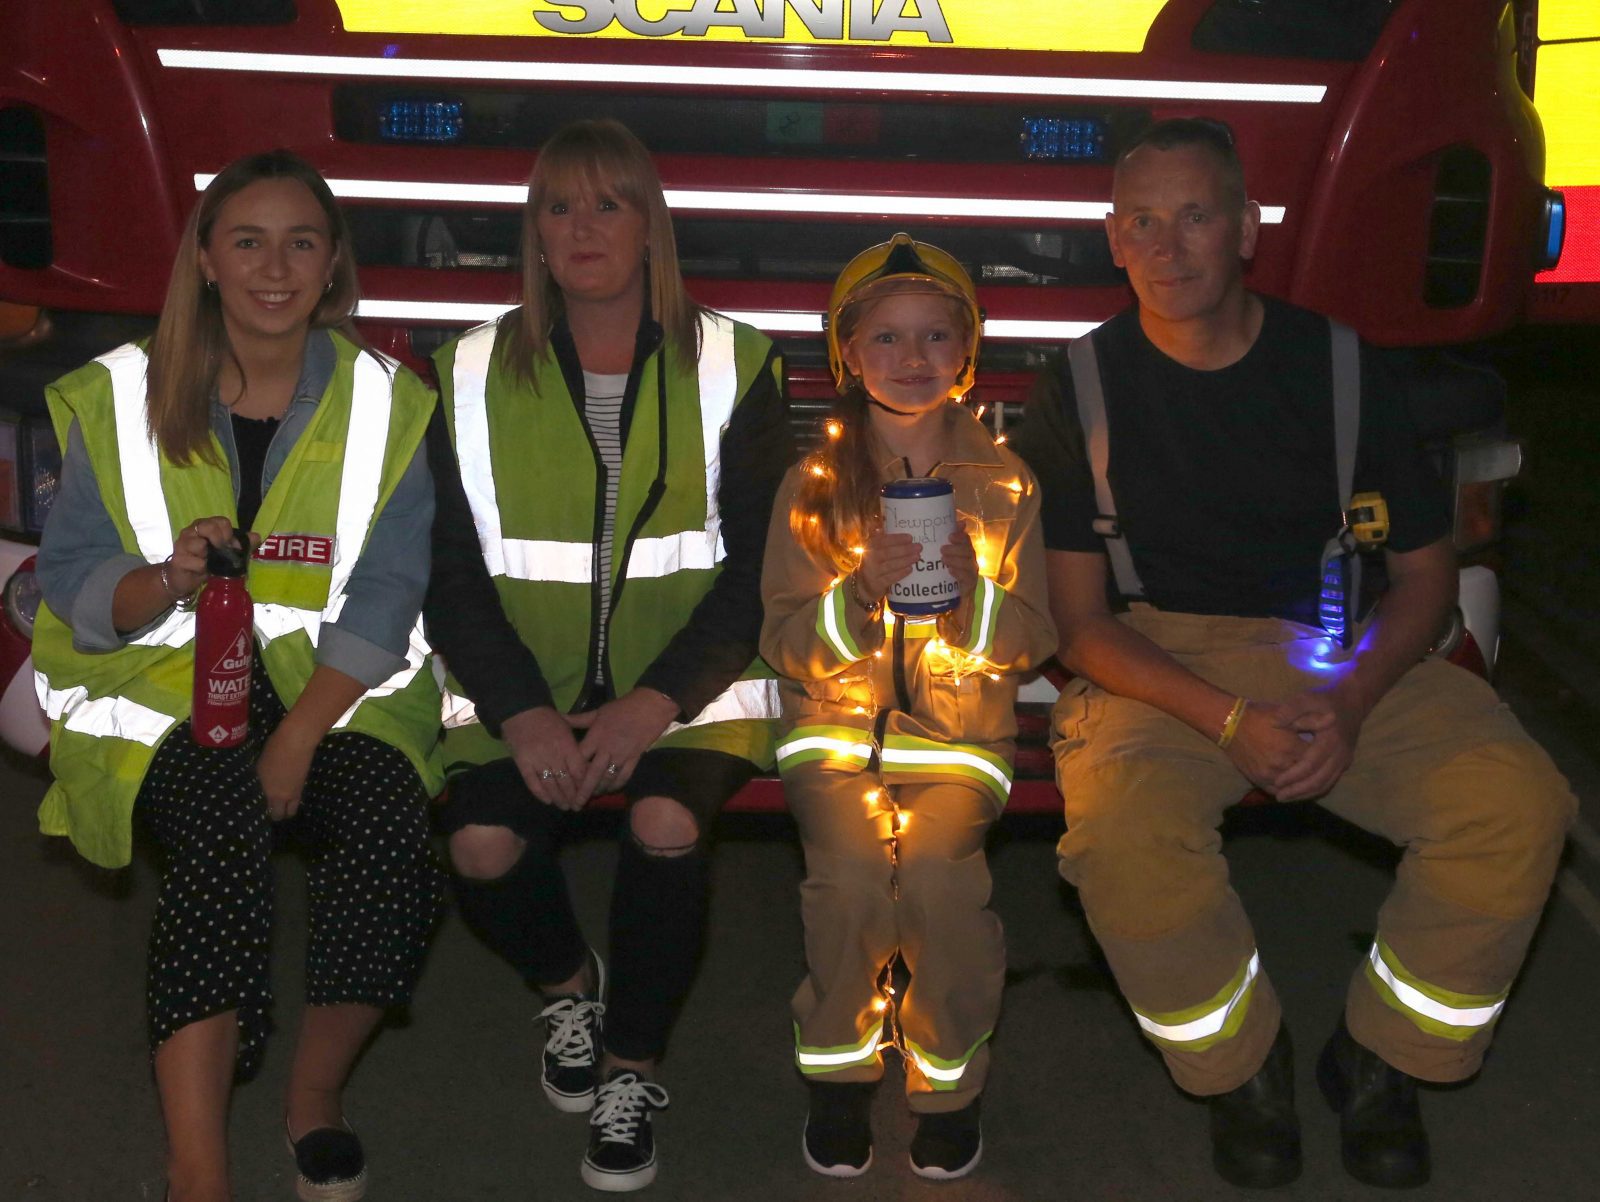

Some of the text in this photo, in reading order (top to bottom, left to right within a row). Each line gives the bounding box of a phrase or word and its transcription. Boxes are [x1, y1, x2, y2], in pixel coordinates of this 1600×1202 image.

[258, 537, 326, 560] FIRE
[894, 580, 960, 598] Collection
[208, 675, 251, 694] WATE
